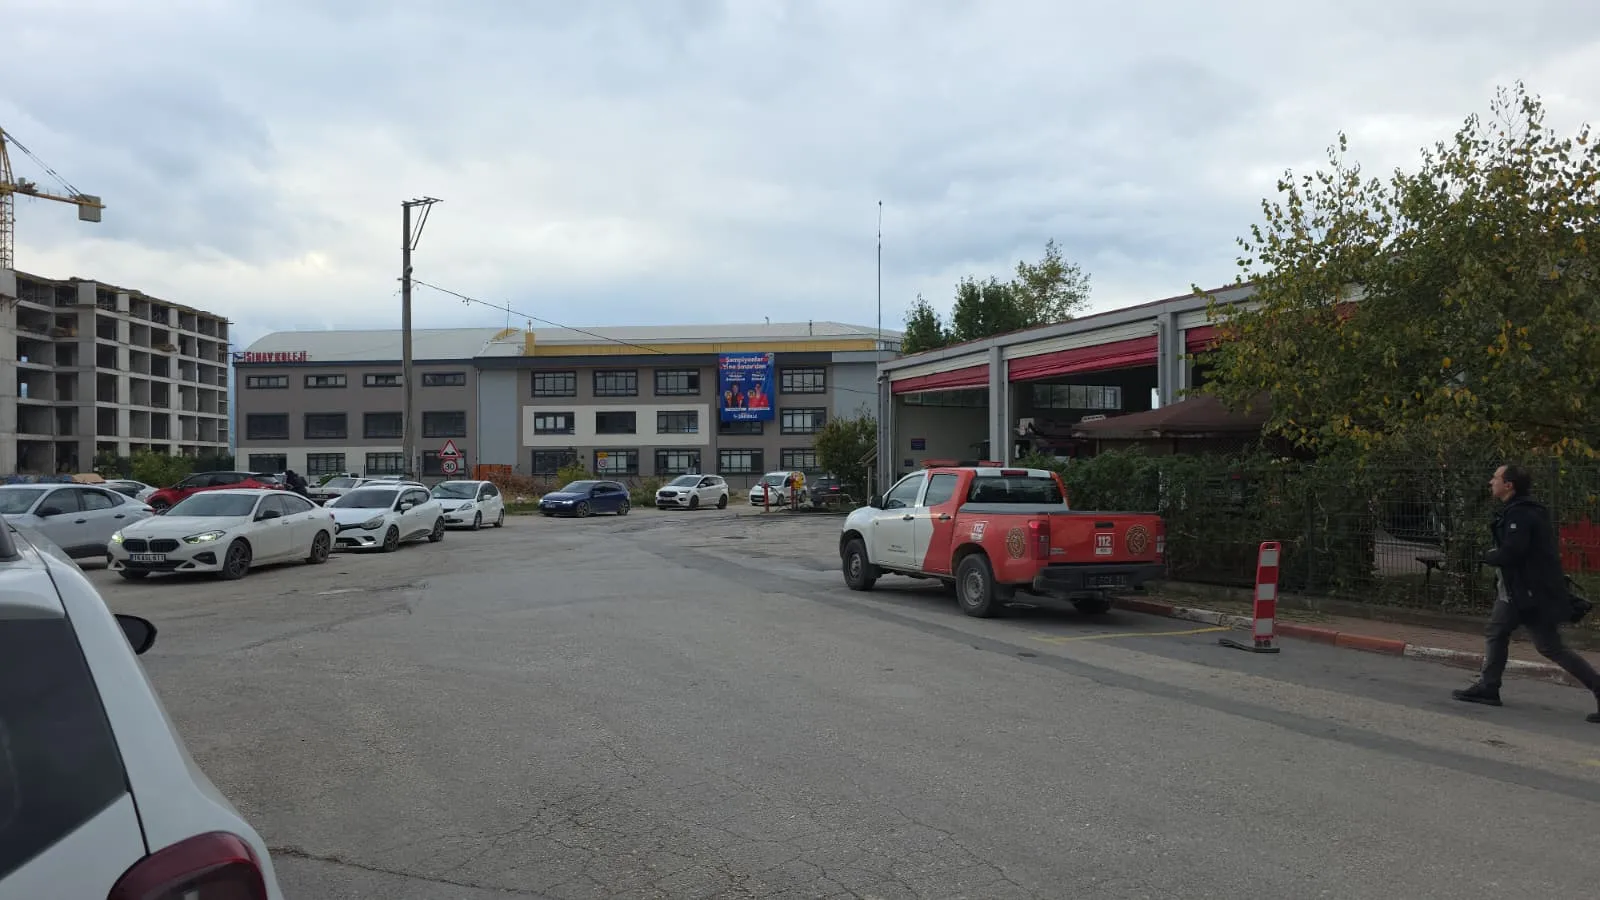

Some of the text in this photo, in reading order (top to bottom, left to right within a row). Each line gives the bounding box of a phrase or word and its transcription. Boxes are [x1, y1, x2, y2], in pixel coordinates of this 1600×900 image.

[246, 352, 273, 363] SINAV
[445, 462, 455, 470] 30
[1098, 535, 1111, 547] 112
